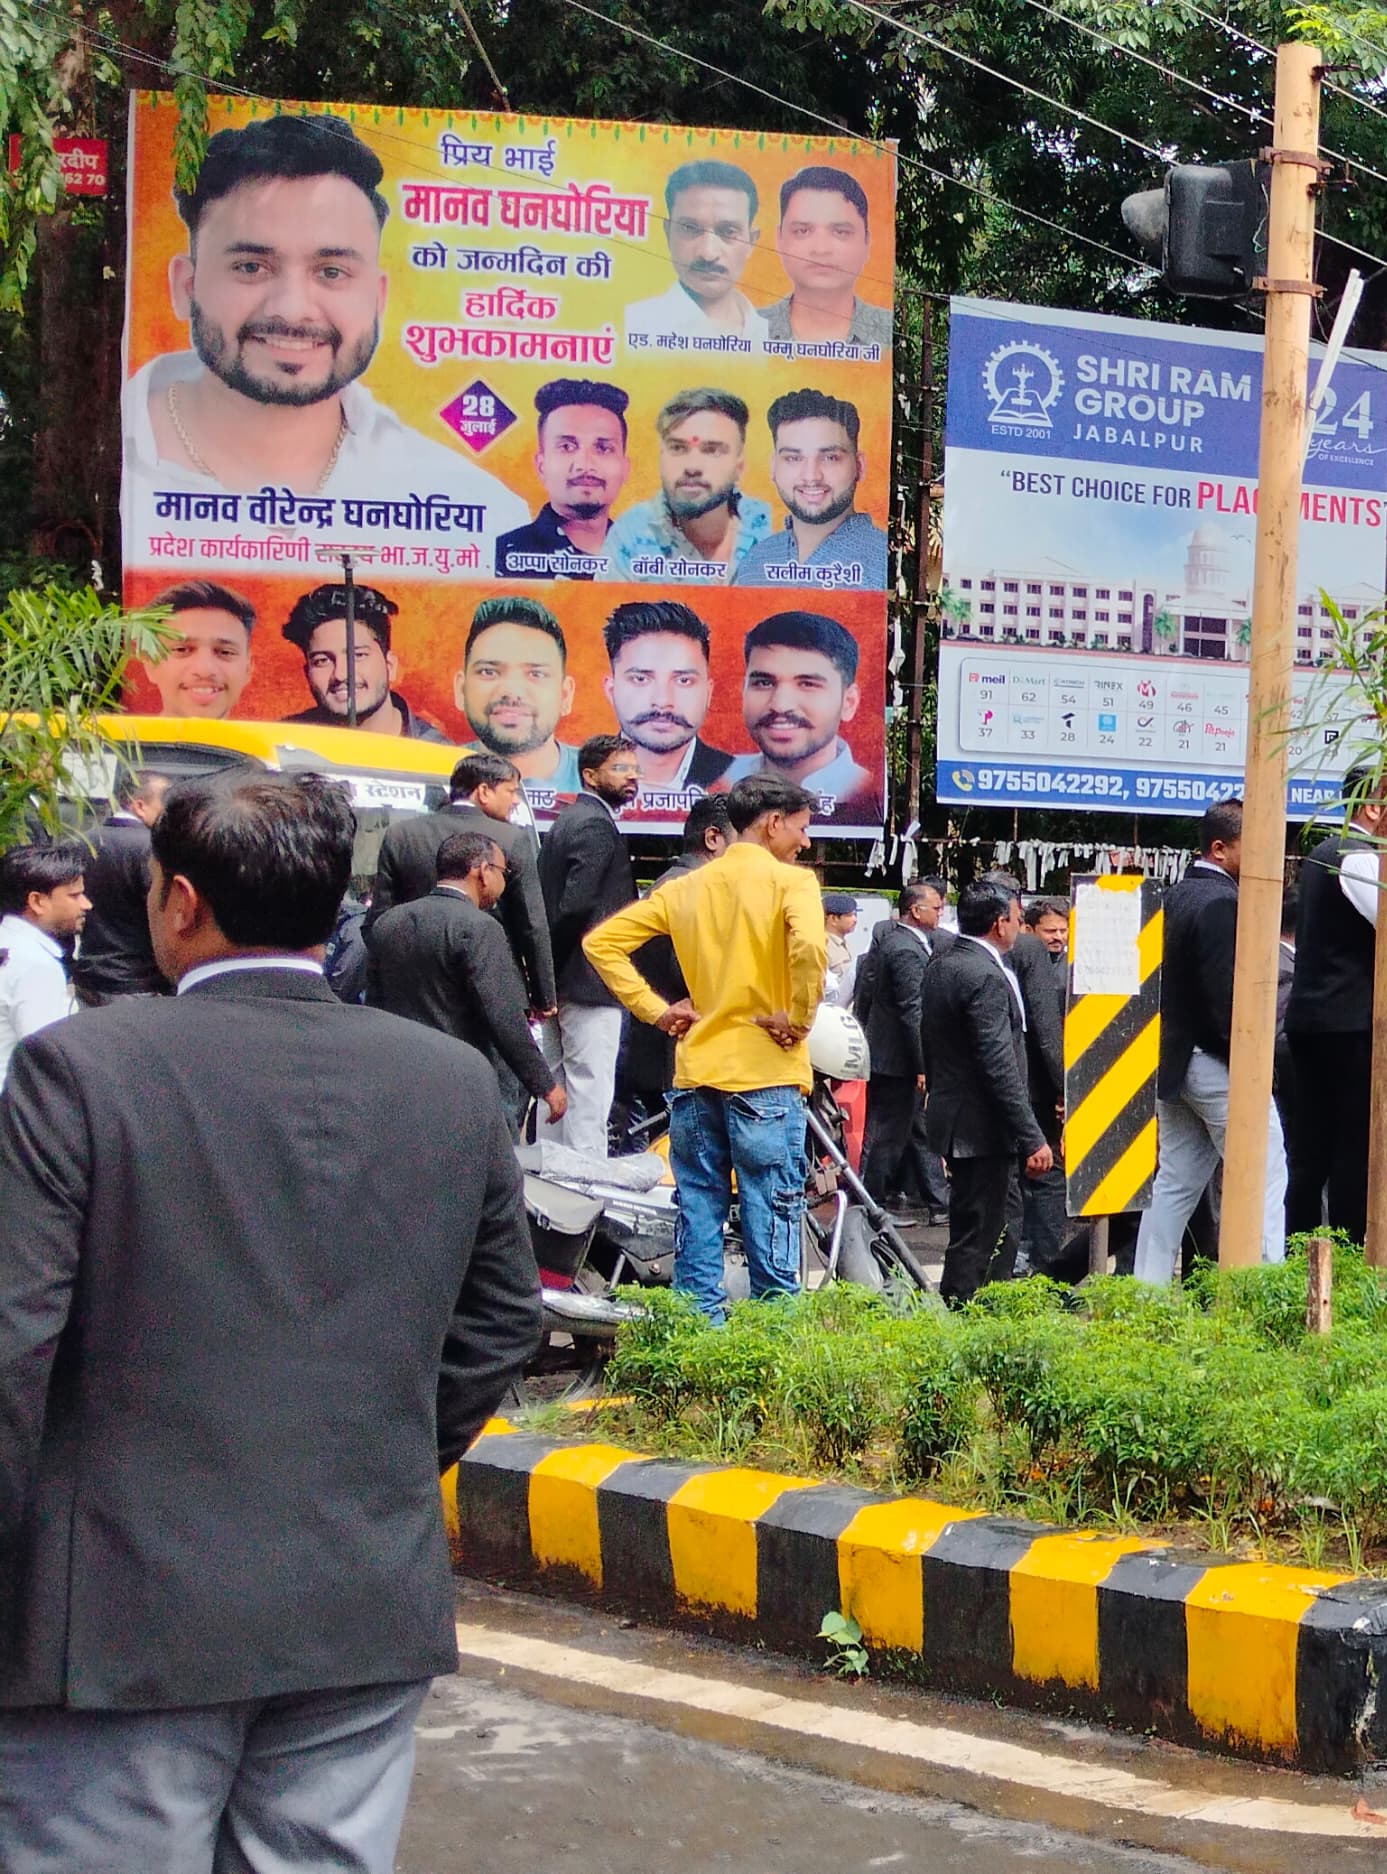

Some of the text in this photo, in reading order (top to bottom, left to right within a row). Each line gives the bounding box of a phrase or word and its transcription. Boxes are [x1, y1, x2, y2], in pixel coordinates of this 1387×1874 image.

[441, 134, 556, 176] प्रिय भाई
[402, 183, 649, 236] मानव घनघोरिया
[412, 242, 612, 278] को जन्मदिन की
[465, 287, 558, 319] हार्दिक
[406, 326, 615, 364] शुभकामनाएं
[656, 331, 689, 350] महेश
[693, 333, 751, 352] घनघोरिया
[796, 340, 859, 359] घनघोरिया
[860, 343, 880, 360] जी
[1076, 354, 1251, 402] SHRI RAM
[462, 395, 495, 416] 28
[1076, 389, 1205, 427] GROUP
[1310, 387, 1374, 439] 24
[460, 418, 497, 436] जुलाई
[992, 425, 1052, 440] ESTD 2001
[1073, 423, 1203, 453] JABALPUR
[1072, 477, 1146, 504] CHOICE
[1153, 484, 1191, 508] FOR
[153, 487, 486, 532] मानव वीरेन्द्र घनघोरिया
[149, 531, 193, 557] प्रदेश
[199, 534, 311, 562] कार्यकारिणी
[506, 551, 608, 573] अप्पा सोनकर
[633, 555, 727, 578] बॉबी सोनकर
[766, 562, 861, 587] सलीम कुरैशी
[980, 690, 993, 700] 91
[1021, 692, 1037, 702] 62
[1061, 695, 1077, 705] 54
[1102, 697, 1114, 707] 51
[1139, 700, 1154, 710] 49
[1177, 703, 1192, 713] 46
[1214, 705, 1229, 715] 45
[978, 727, 993, 737] 37
[1021, 730, 1036, 740] 33
[1061, 732, 1076, 742] 28
[1099, 735, 1114, 745] 24
[1138, 737, 1153, 747] 22
[1178, 740, 1190, 749] 21
[1215, 742, 1226, 752] 21
[1288, 746, 1303, 756] 20
[977, 769, 1130, 799] 9755042292,
